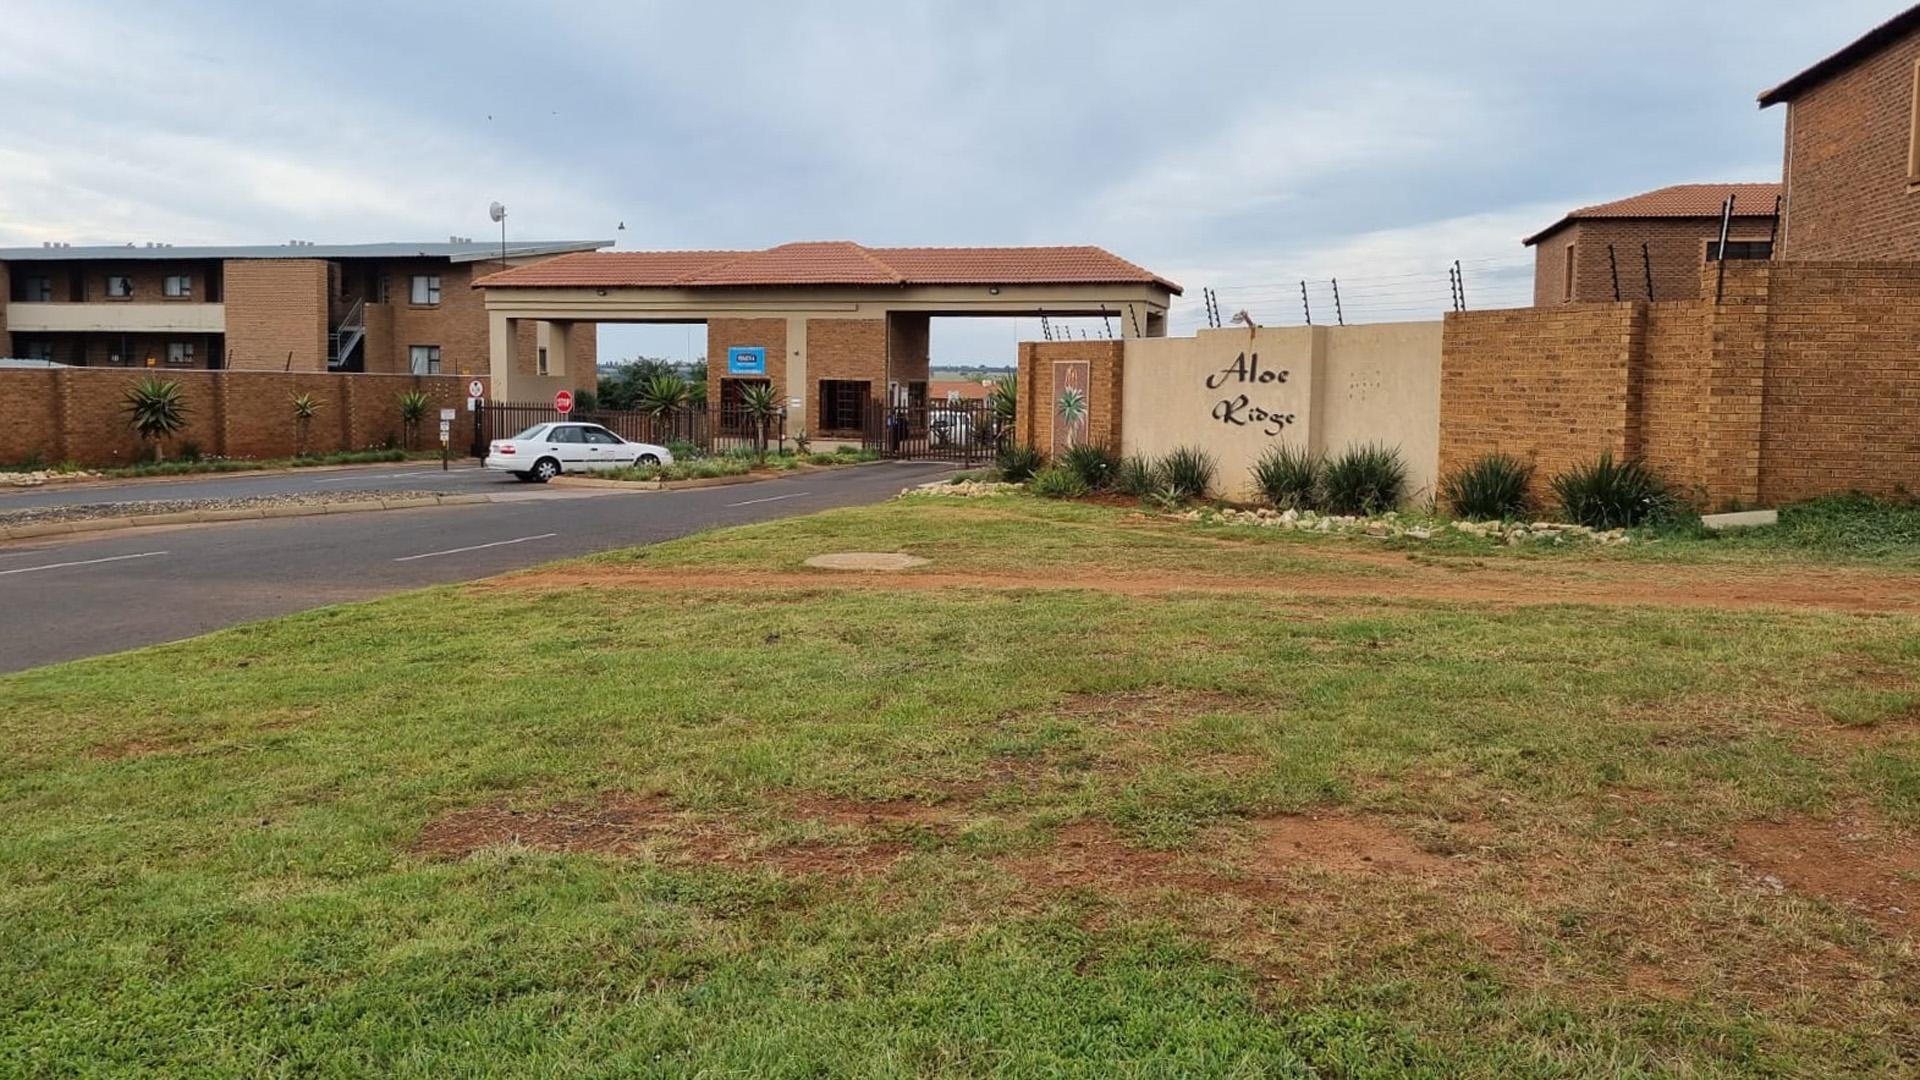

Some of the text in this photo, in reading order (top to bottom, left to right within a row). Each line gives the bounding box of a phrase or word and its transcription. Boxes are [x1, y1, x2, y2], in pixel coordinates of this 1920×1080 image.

[1206, 352, 1290, 389] Aloe
[557, 398, 570, 407] STOP
[1212, 394, 1296, 436] Ridge
